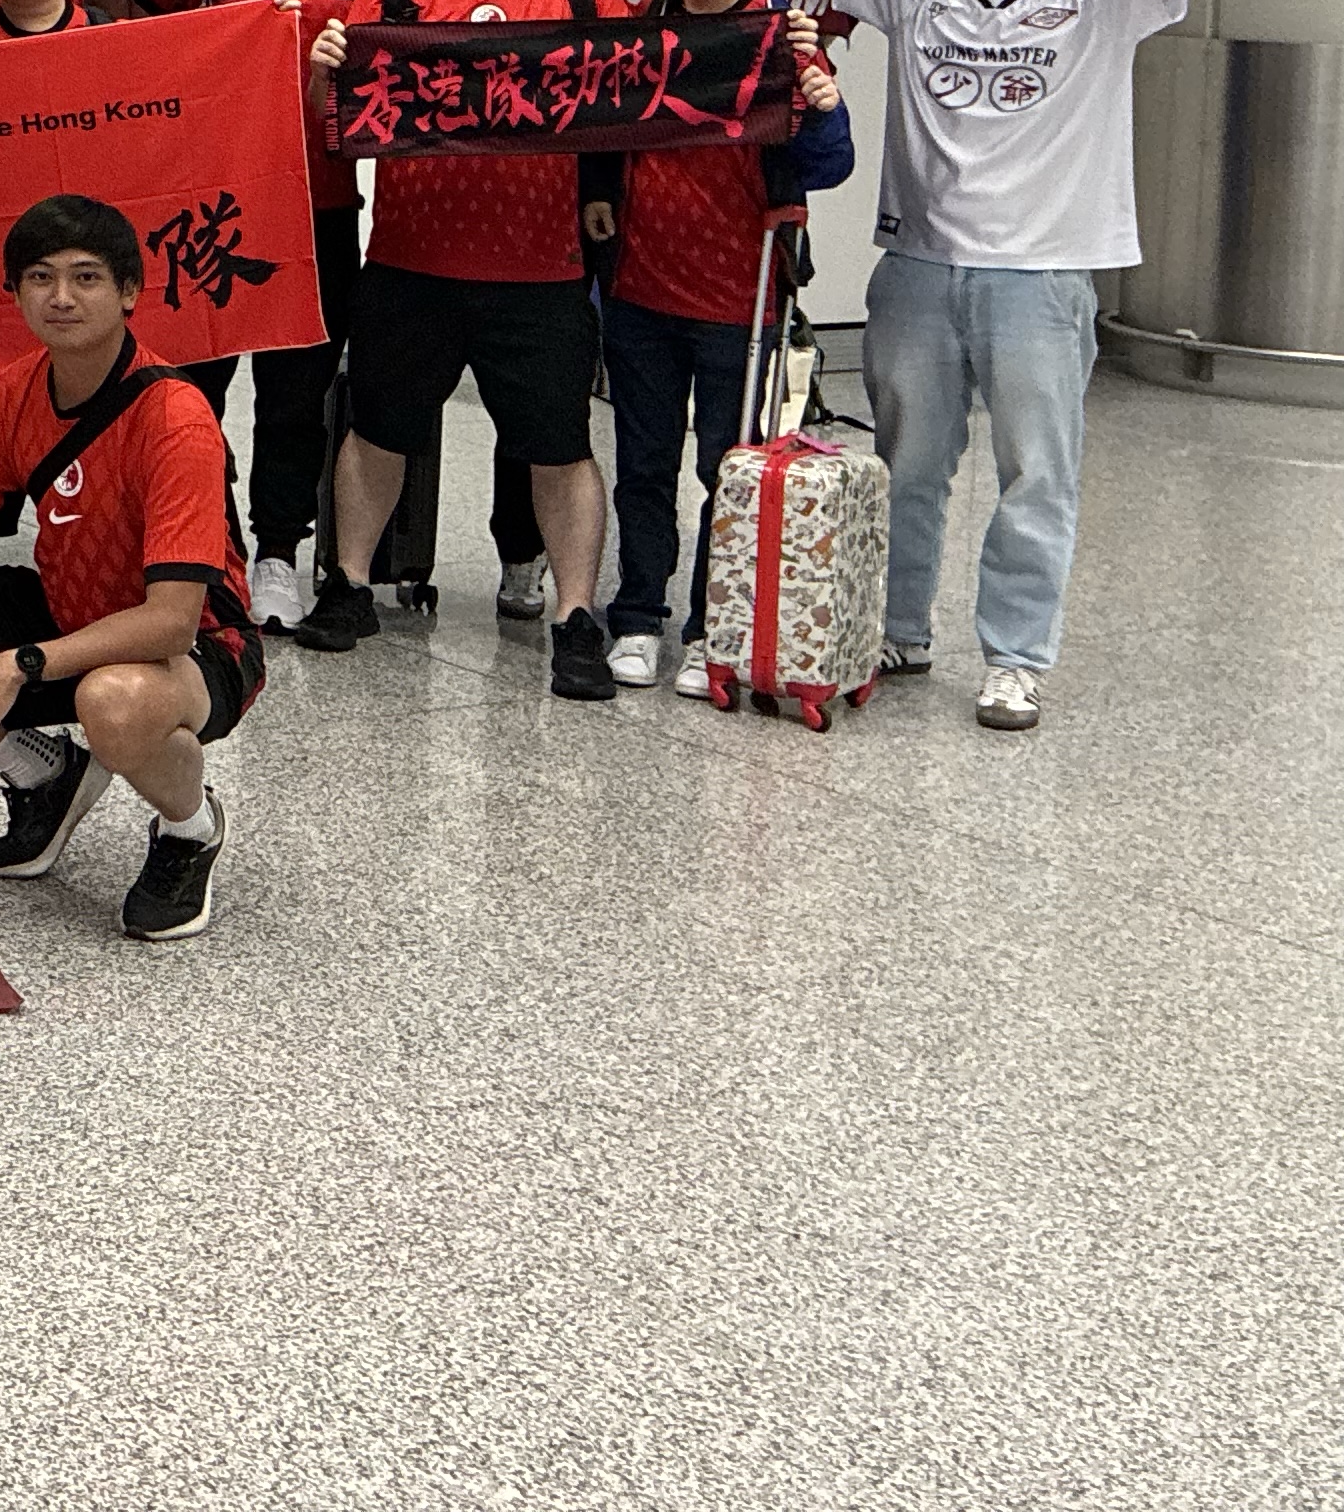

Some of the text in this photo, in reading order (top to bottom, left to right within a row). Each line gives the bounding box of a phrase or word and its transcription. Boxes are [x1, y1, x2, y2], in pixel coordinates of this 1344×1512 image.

[922, 44, 1058, 68] YOUNG MASTER
[20, 109, 97, 135] Hong
[104, 96, 182, 122] Kong
